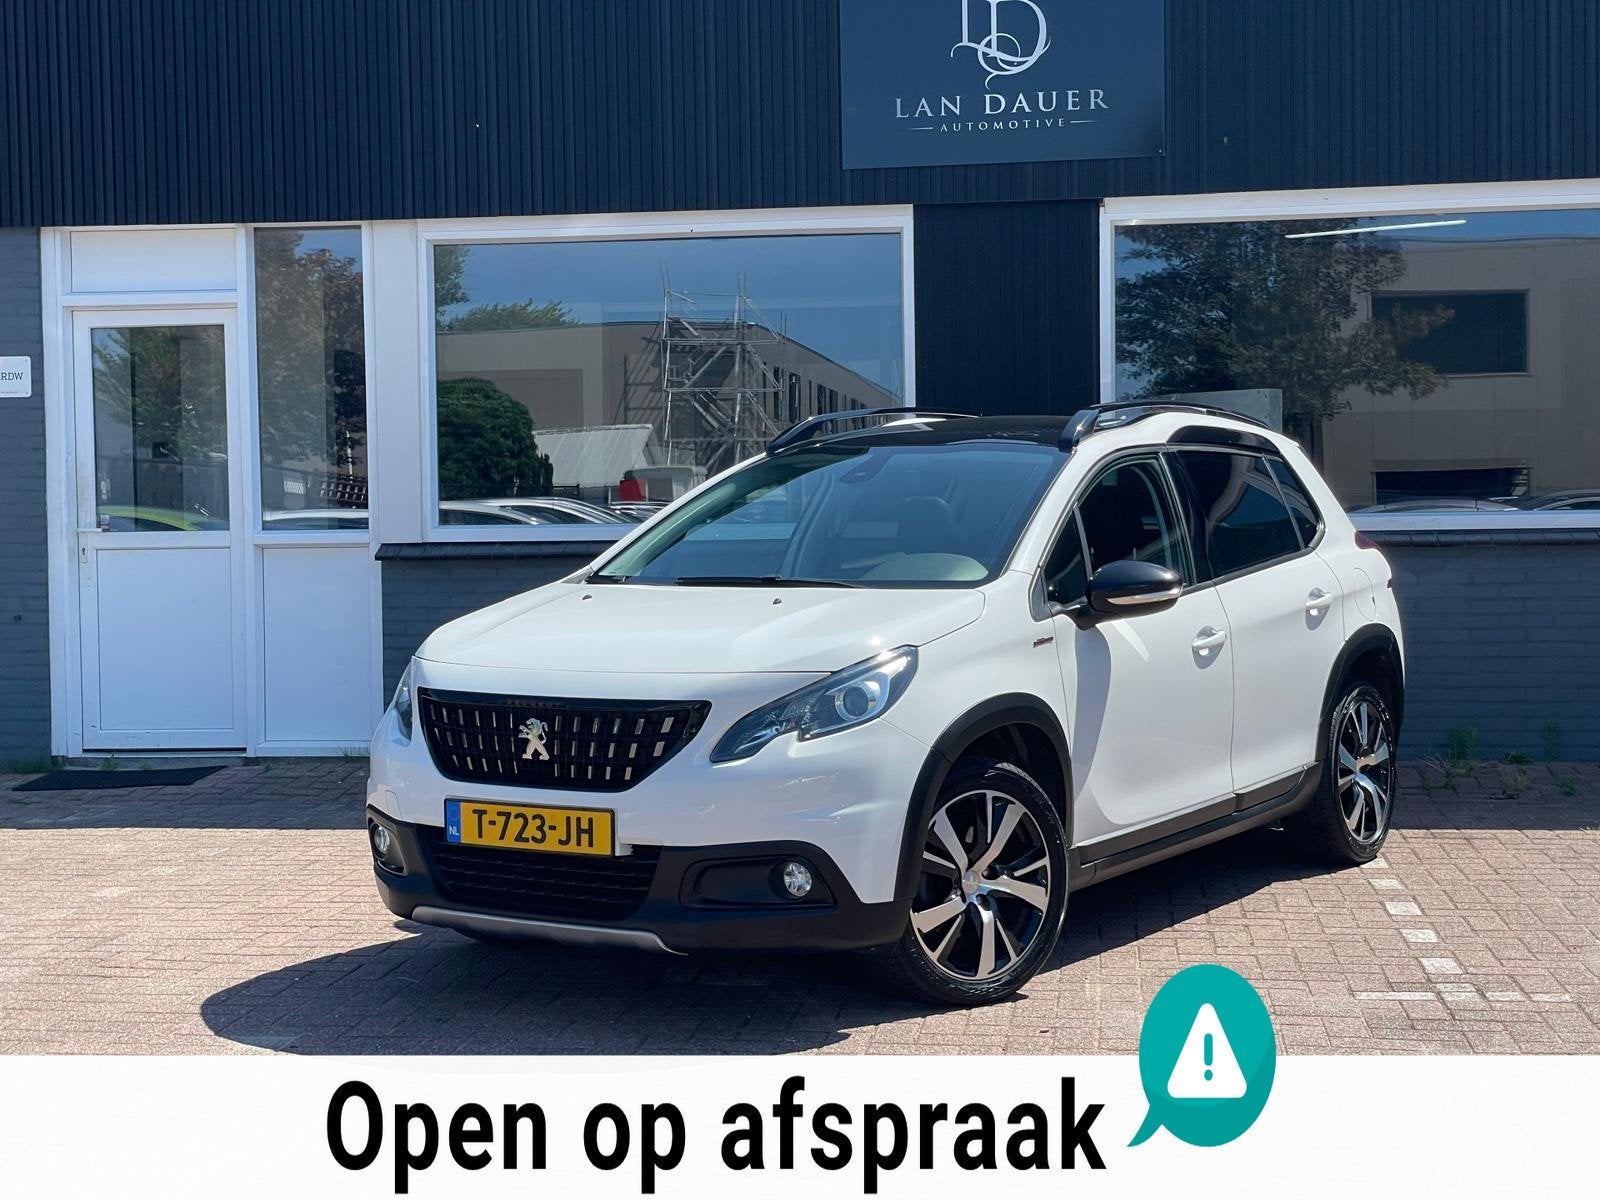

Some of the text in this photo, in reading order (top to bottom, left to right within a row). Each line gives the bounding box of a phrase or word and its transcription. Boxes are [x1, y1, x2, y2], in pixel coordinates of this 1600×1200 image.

[896, 88, 1109, 118] LAN DAUER
[940, 118, 1065, 132] AUTOMOTIVE
[1, 372, 23, 381] RDW
[449, 825, 460, 836] NL
[471, 808, 595, 848] T-723-JH
